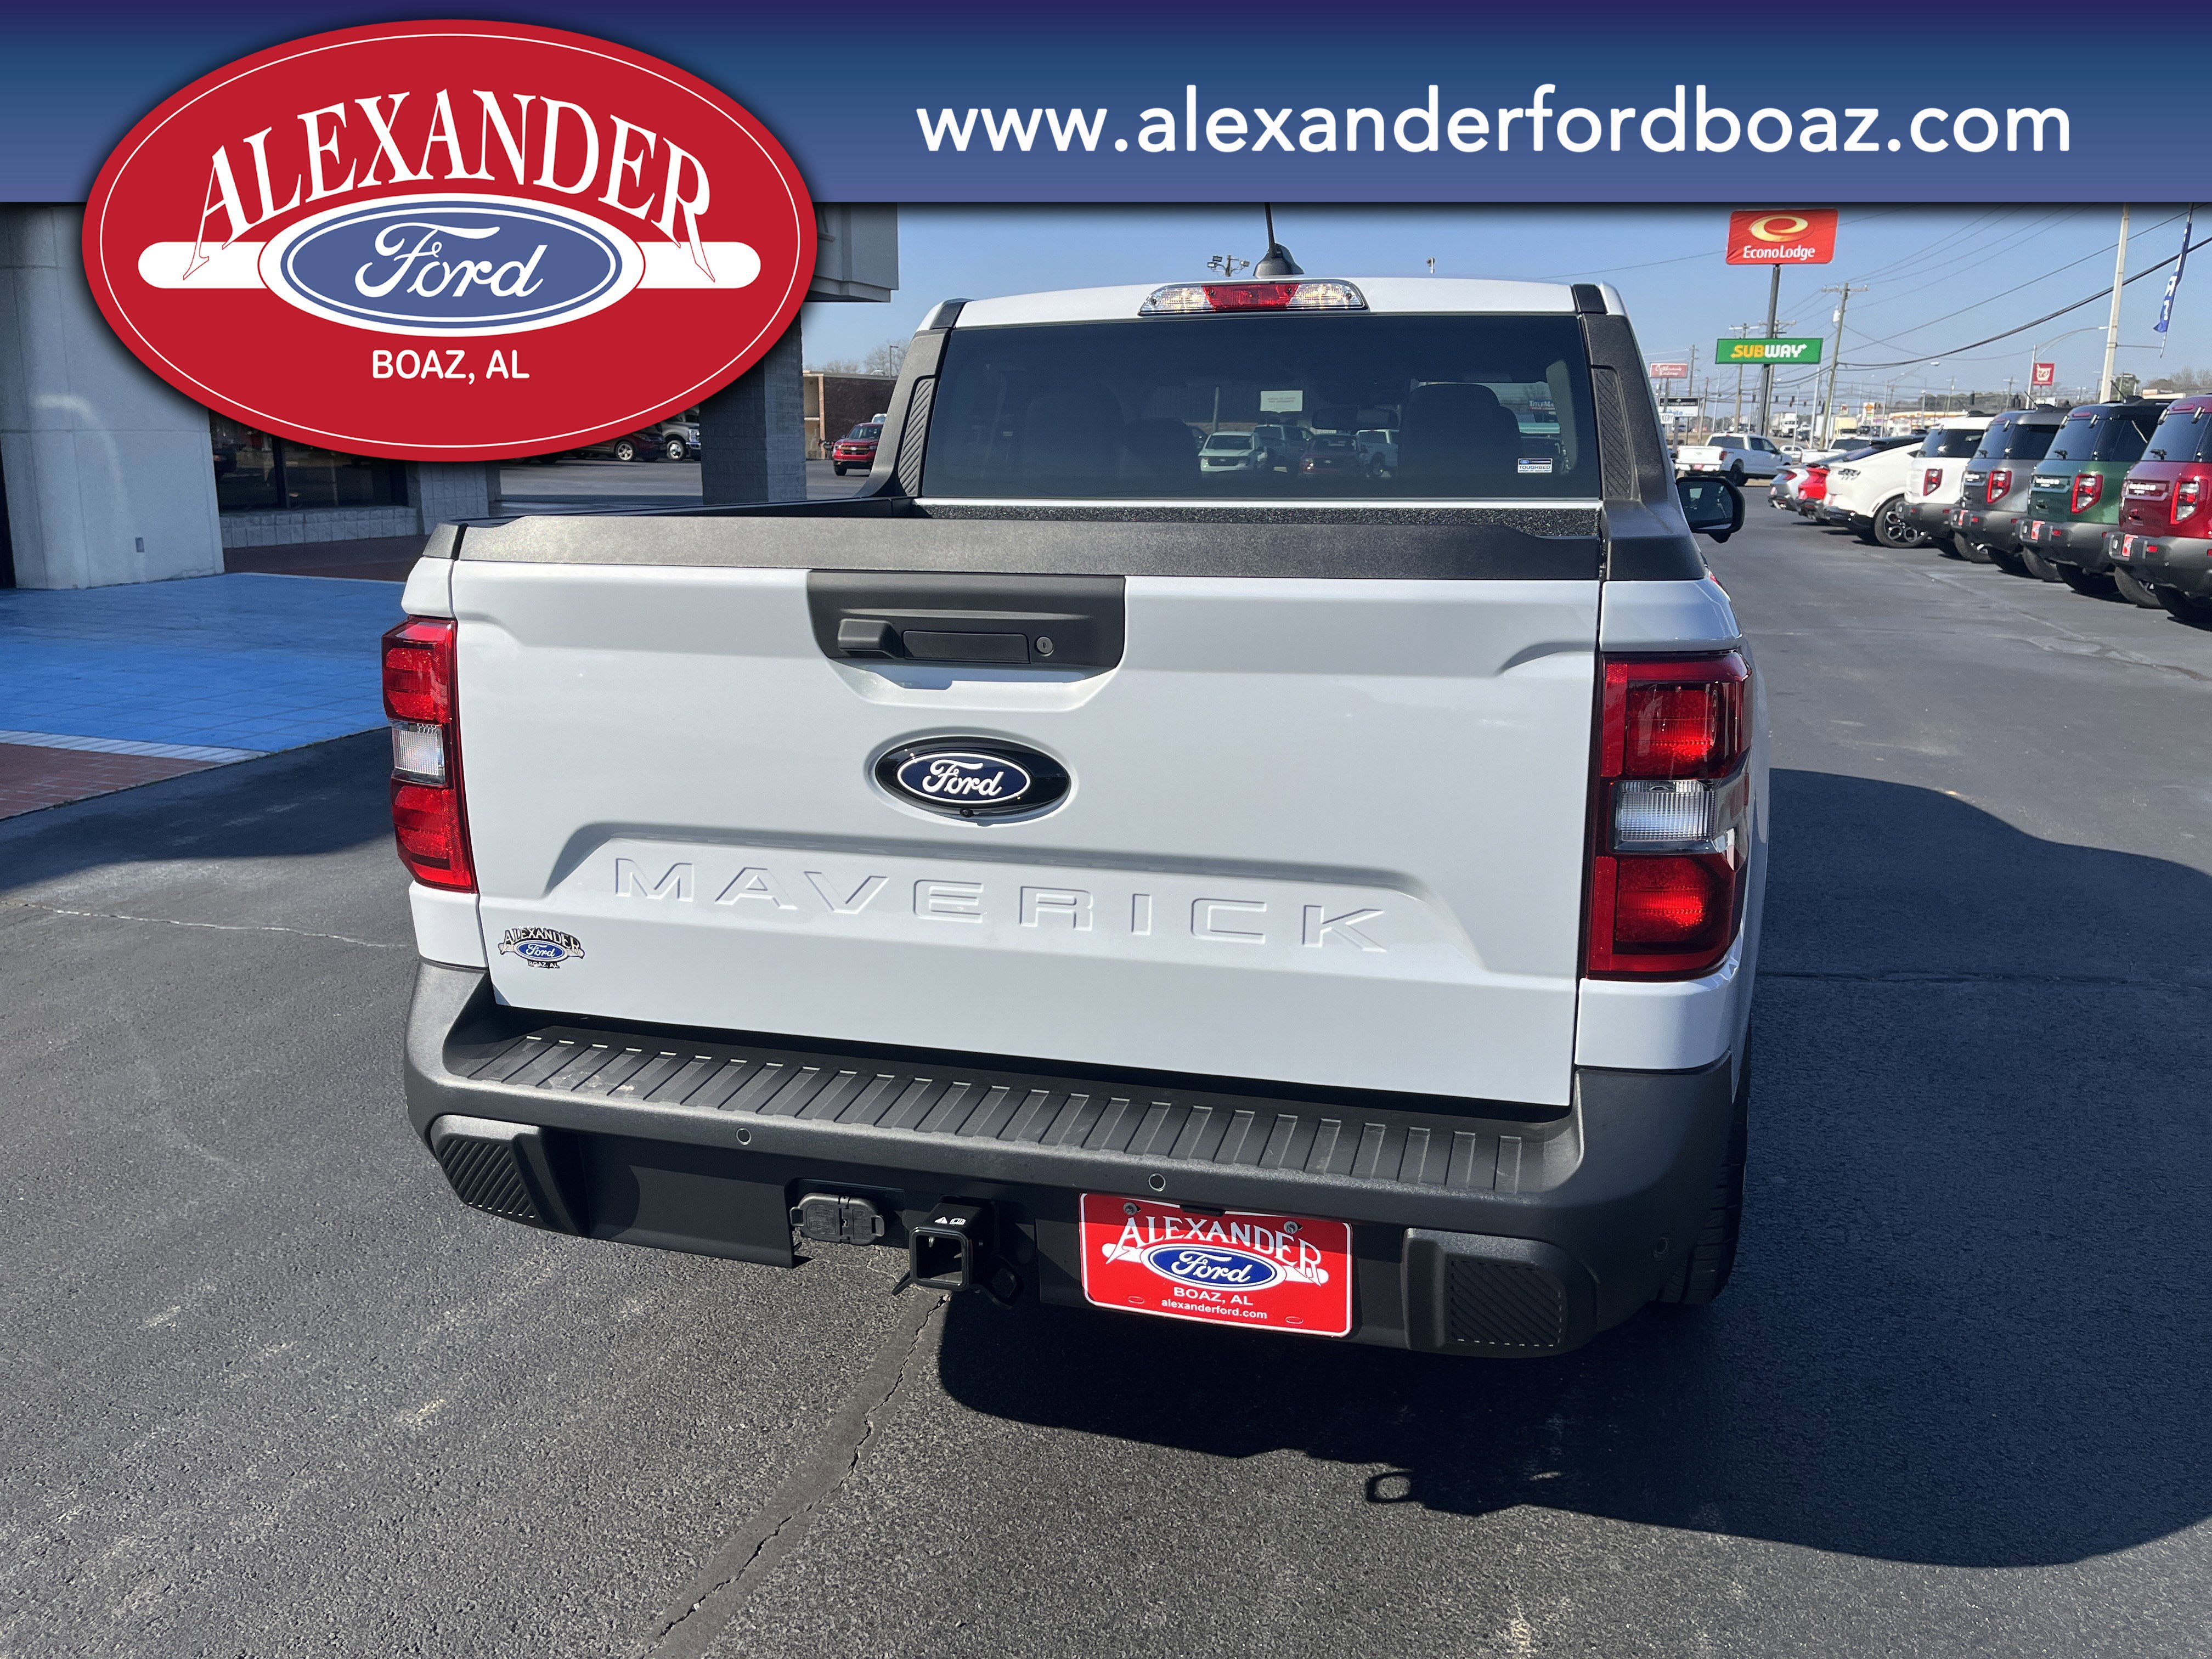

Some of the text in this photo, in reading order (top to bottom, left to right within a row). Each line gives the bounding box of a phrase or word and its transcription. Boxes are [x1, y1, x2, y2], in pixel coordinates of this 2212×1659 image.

[1743, 244, 1815, 261] EconoLodge
[1731, 343, 1807, 358] SUBWAY
[922, 759, 1004, 796] Ford
[616, 857, 1387, 952] MAVERICK
[501, 927, 584, 958] ALEXANDER
[526, 943, 556, 957] Ford
[1105, 1215, 1322, 1286] ALEXANDER
[1170, 1250, 1252, 1283] Ford
[1173, 1286, 1254, 1306] BOAZ, AL
[1161, 1299, 1268, 1320] alexanderford.com
